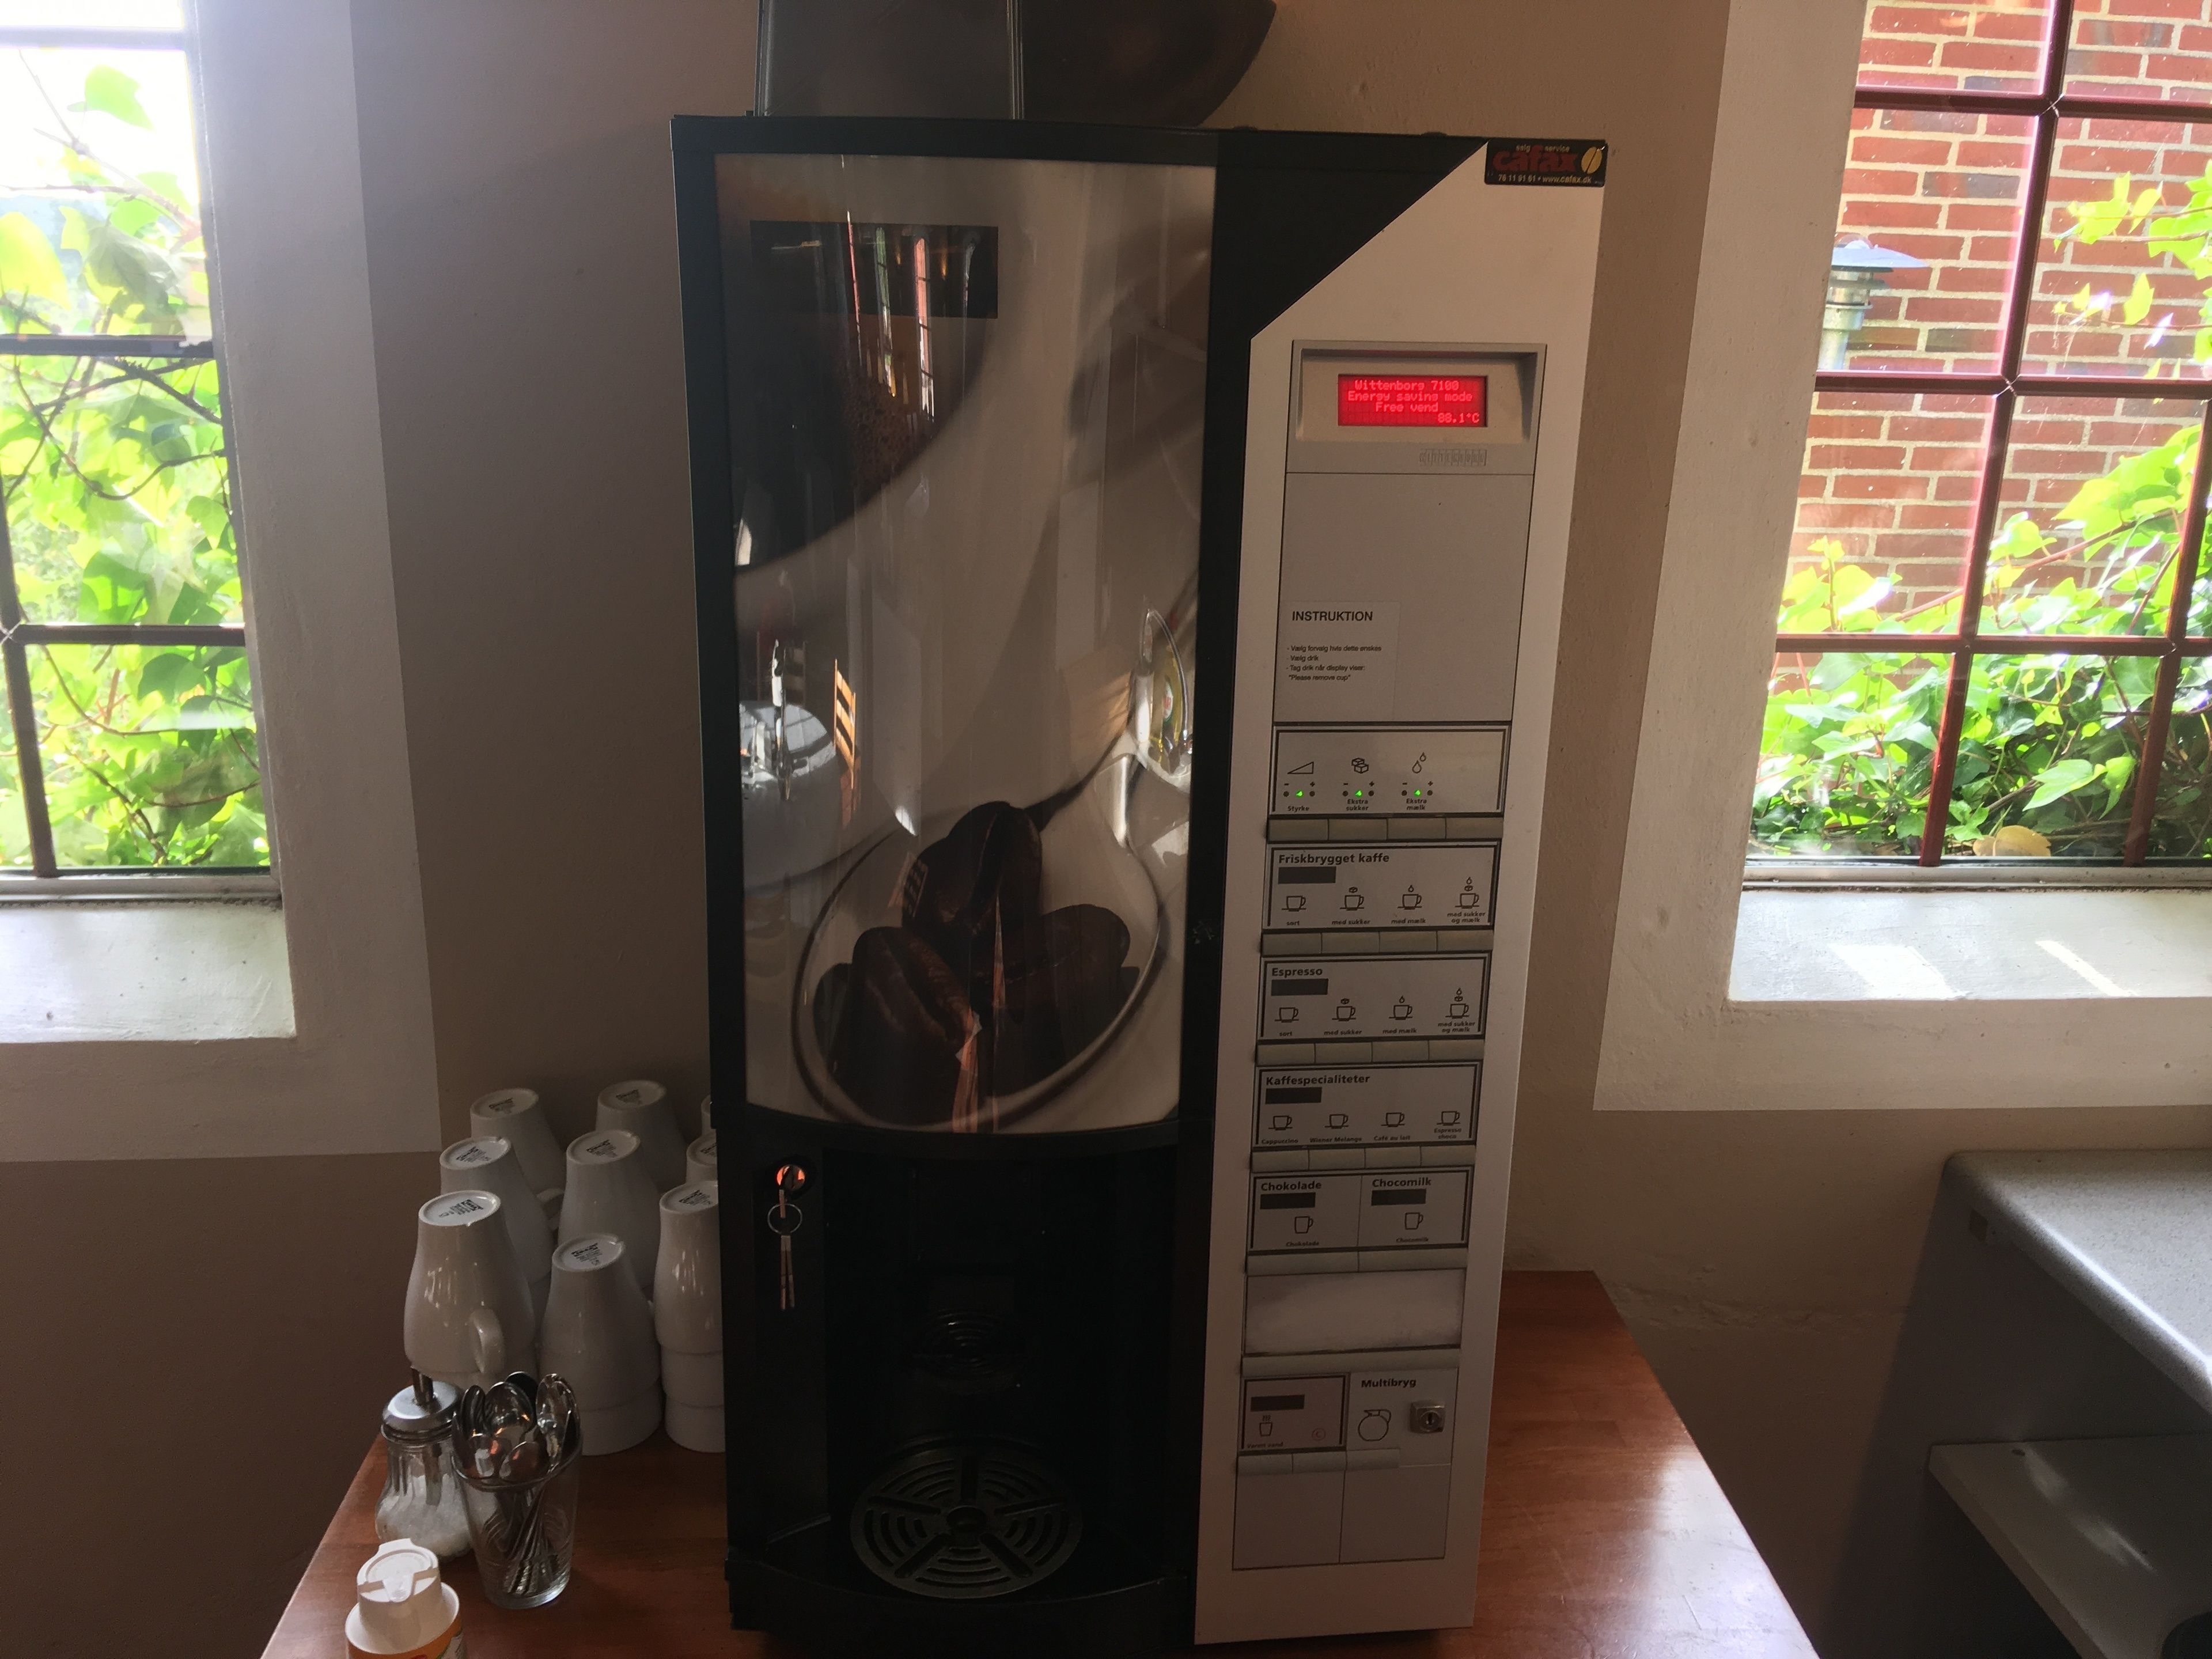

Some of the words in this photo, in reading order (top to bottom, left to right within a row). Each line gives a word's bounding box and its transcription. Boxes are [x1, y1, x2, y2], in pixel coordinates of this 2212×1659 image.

[1493, 145, 1578, 172] cafax
[1542, 175, 1592, 183] www.cafax.dk
[1354, 380, 1425, 391] Wittenborg
[1431, 381, 1459, 391] 7100
[1348, 391, 1390, 402] Energy
[1396, 392, 1438, 402] saving
[1445, 391, 1473, 402] mode
[1376, 402, 1404, 412] Free
[1410, 403, 1438, 412] vend
[1292, 611, 1373, 621] INSTRUKTION
[1278, 853, 1354, 865] Friskbrygget
[1358, 853, 1389, 863] kaffe
[1272, 968, 1323, 978] Espresso
[1266, 1075, 1370, 1086] Kaffespecialiteter
[1261, 1181, 1321, 1191] Chokolade
[1372, 1177, 1431, 1187] Chocomilk
[1361, 1378, 1416, 1389] Multibryg
